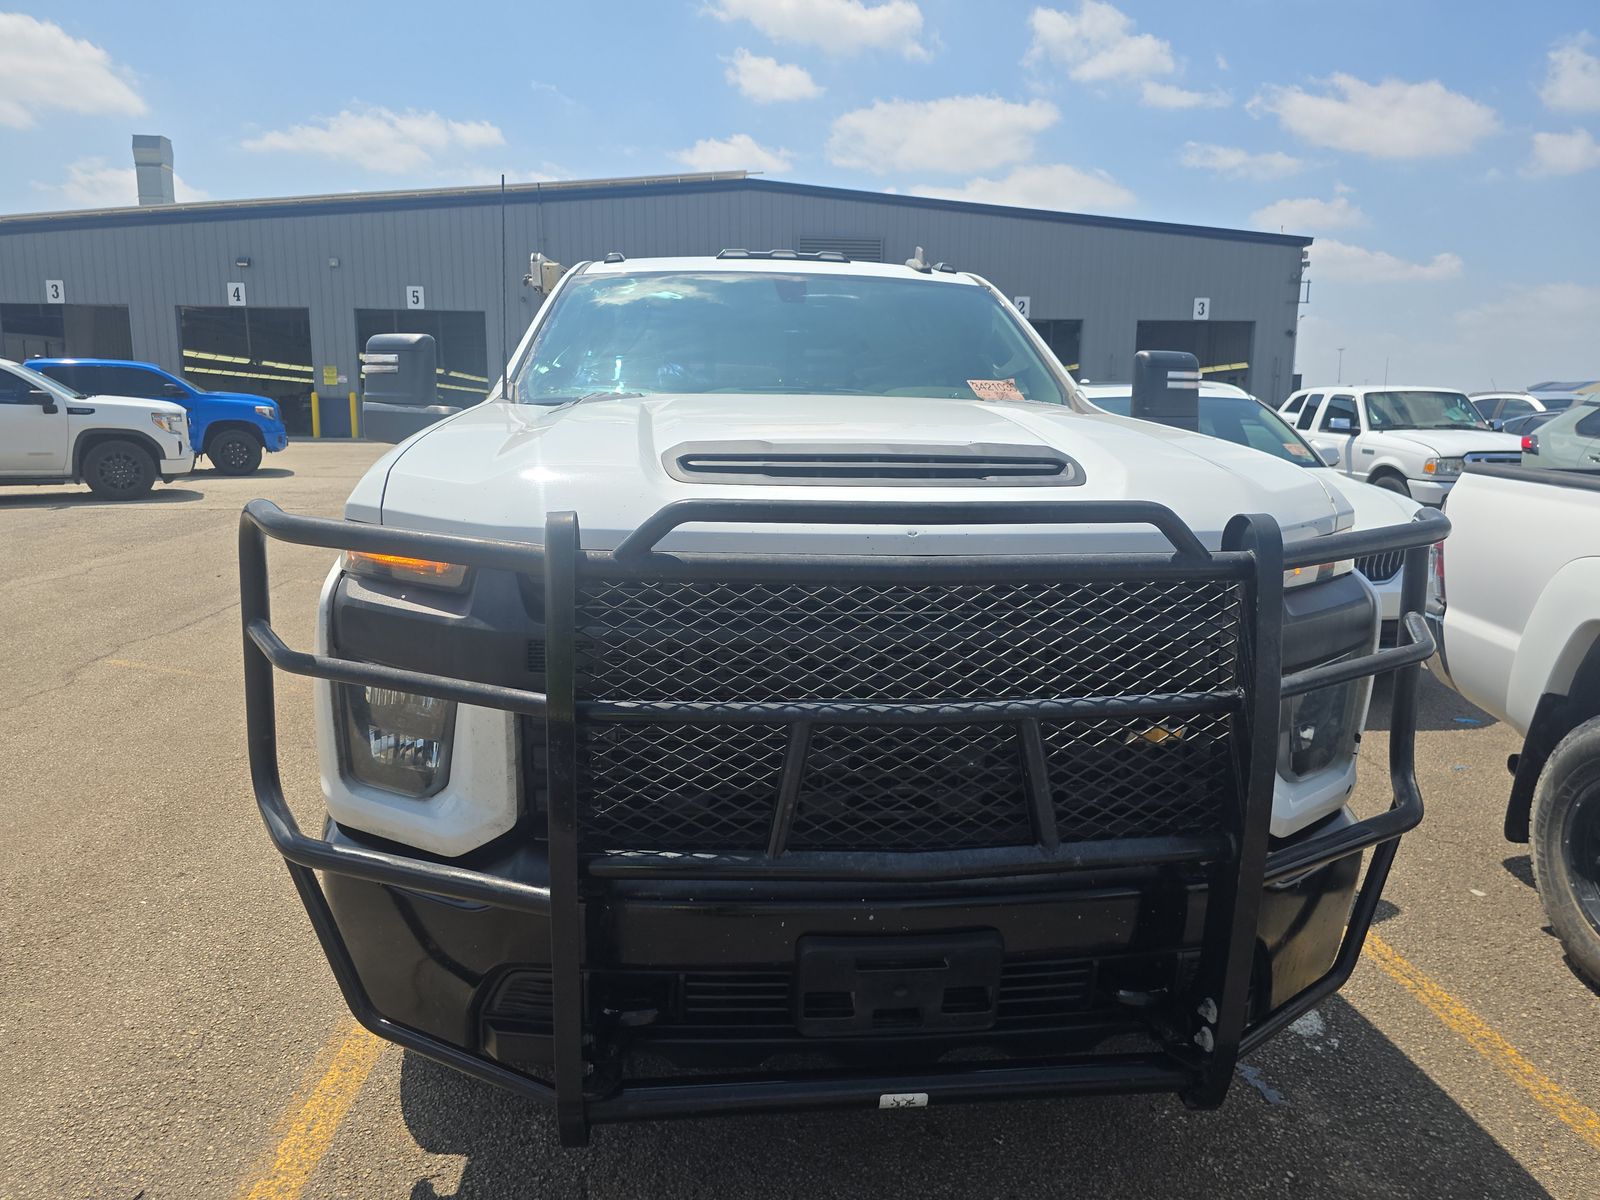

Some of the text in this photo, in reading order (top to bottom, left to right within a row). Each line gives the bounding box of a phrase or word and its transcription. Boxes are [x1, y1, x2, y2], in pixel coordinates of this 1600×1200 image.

[51, 284, 60, 299] 3
[232, 286, 241, 302] 4
[412, 290, 420, 305] 5
[1018, 300, 1025, 315] 2
[1197, 302, 1205, 316] 3
